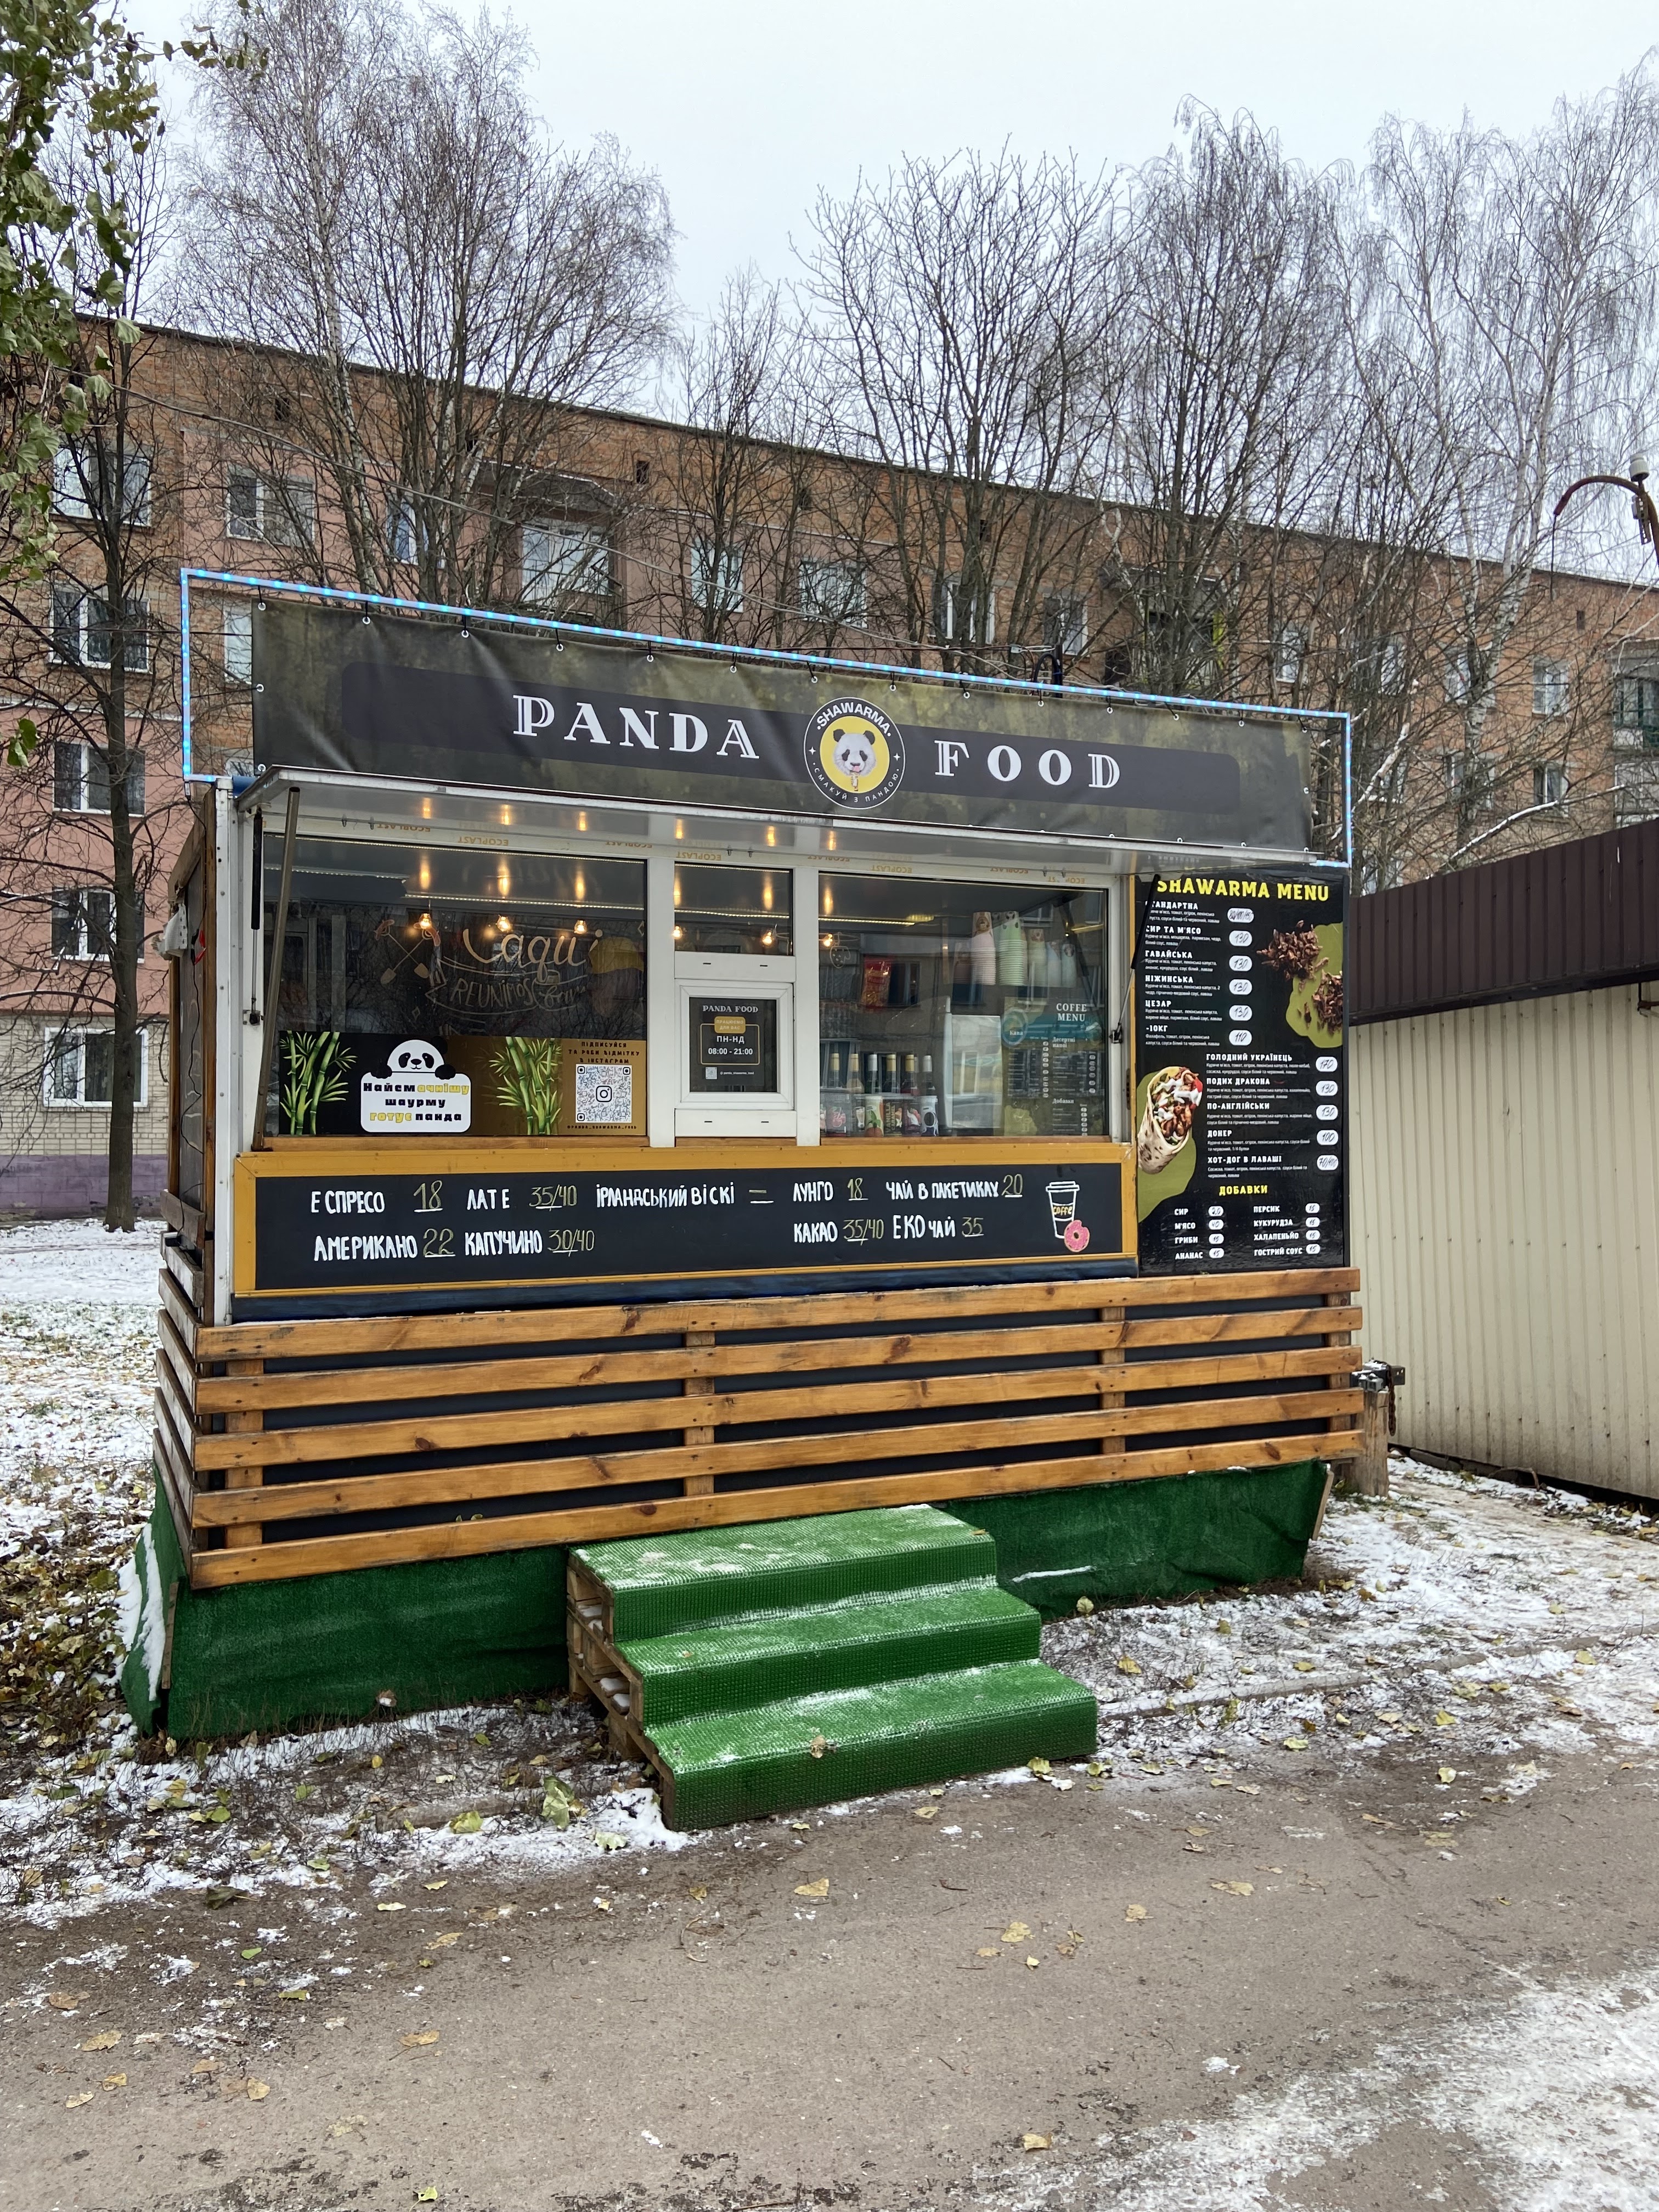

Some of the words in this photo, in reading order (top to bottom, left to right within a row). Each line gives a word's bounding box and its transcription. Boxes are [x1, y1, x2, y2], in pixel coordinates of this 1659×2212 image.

[817, 702, 889, 733] SHAWARMA
[512, 695, 760, 759] PANDA
[934, 740, 1120, 789] FOOD
[814, 768, 847, 800] СМАКУЙ
[865, 774, 899, 802] ПАНДОЮ
[458, 836, 509, 846] ECOPLAST
[675, 851, 721, 861] ECOPLAST
[1048, 876, 1086, 884] ECOPST
[1157, 878, 1270, 898] SHAWARMA
[1277, 883, 1329, 901] MENU
[1235, 933, 1249, 943] 130
[1145, 950, 1193, 958] ГАВАЙСЬКА
[1234, 958, 1248, 969] 130
[1145, 975, 1193, 983] НІЖИНСЬКА
[1234, 982, 1248, 992] 130
[1056, 1003, 1087, 1012] COFFE
[1234, 1006, 1249, 1017] 130
[1057, 1013, 1086, 1022] MENU
[716, 1036, 745, 1044] ПН-НД
[1235, 1032, 1247, 1042] 110
[1206, 1053, 1248, 1061] ГОЛОДНИЙ
[1251, 1053, 1293, 1062] УКРАЇНЕЦЬ
[1319, 1059, 1334, 1070] 170
[1206, 1077, 1233, 1086] ПОДИХ
[1235, 1077, 1270, 1086] ДРАКОНА
[363, 1082, 470, 1095] Найсмачнішу
[1321, 1084, 1335, 1093] 130
[385, 1099, 445, 1108] шаурму
[1207, 1102, 1270, 1110] ПО-АНГЛІЙСЬКИ
[1322, 1107, 1335, 1116] 130
[370, 1113, 412, 1123] готує
[1322, 1132, 1335, 1142] 100
[1207, 1156, 1241, 1164] ХОТ-ДОГ
[848, 1178, 863, 1200] 18
[886, 1180, 914, 1200] ЧАЙ
[918, 1183, 929, 1199] В
[1002, 1173, 1023, 1196] 20
[413, 1180, 443, 1210] 18
[793, 1181, 833, 1201] ЛУНГО
[1219, 1185, 1268, 1196] ДОБАВКИ
[311, 1190, 385, 1214] ЕСПРЕСО
[466, 1189, 510, 1210] ЛАТЕ
[529, 1184, 577, 1211] 35/40
[893, 1215, 926, 1239] ЕКО
[962, 1217, 984, 1235] 35
[1254, 1219, 1293, 1227] КУКУРУДЗА
[794, 1221, 838, 1243] КАКАО
[843, 1218, 884, 1245] 35/40
[1254, 1232, 1299, 1241] ХАЛАПЕНЬЙО
[423, 1228, 454, 1255] 22
[465, 1230, 543, 1255] КАПУЧИНО
[548, 1229, 595, 1256] 30/40
[1175, 1236, 1198, 1244] ГРИБИ
[314, 1235, 418, 1261] АМЕРИКАНО
[1254, 1247, 1284, 1256] ГОСТРИЙ
